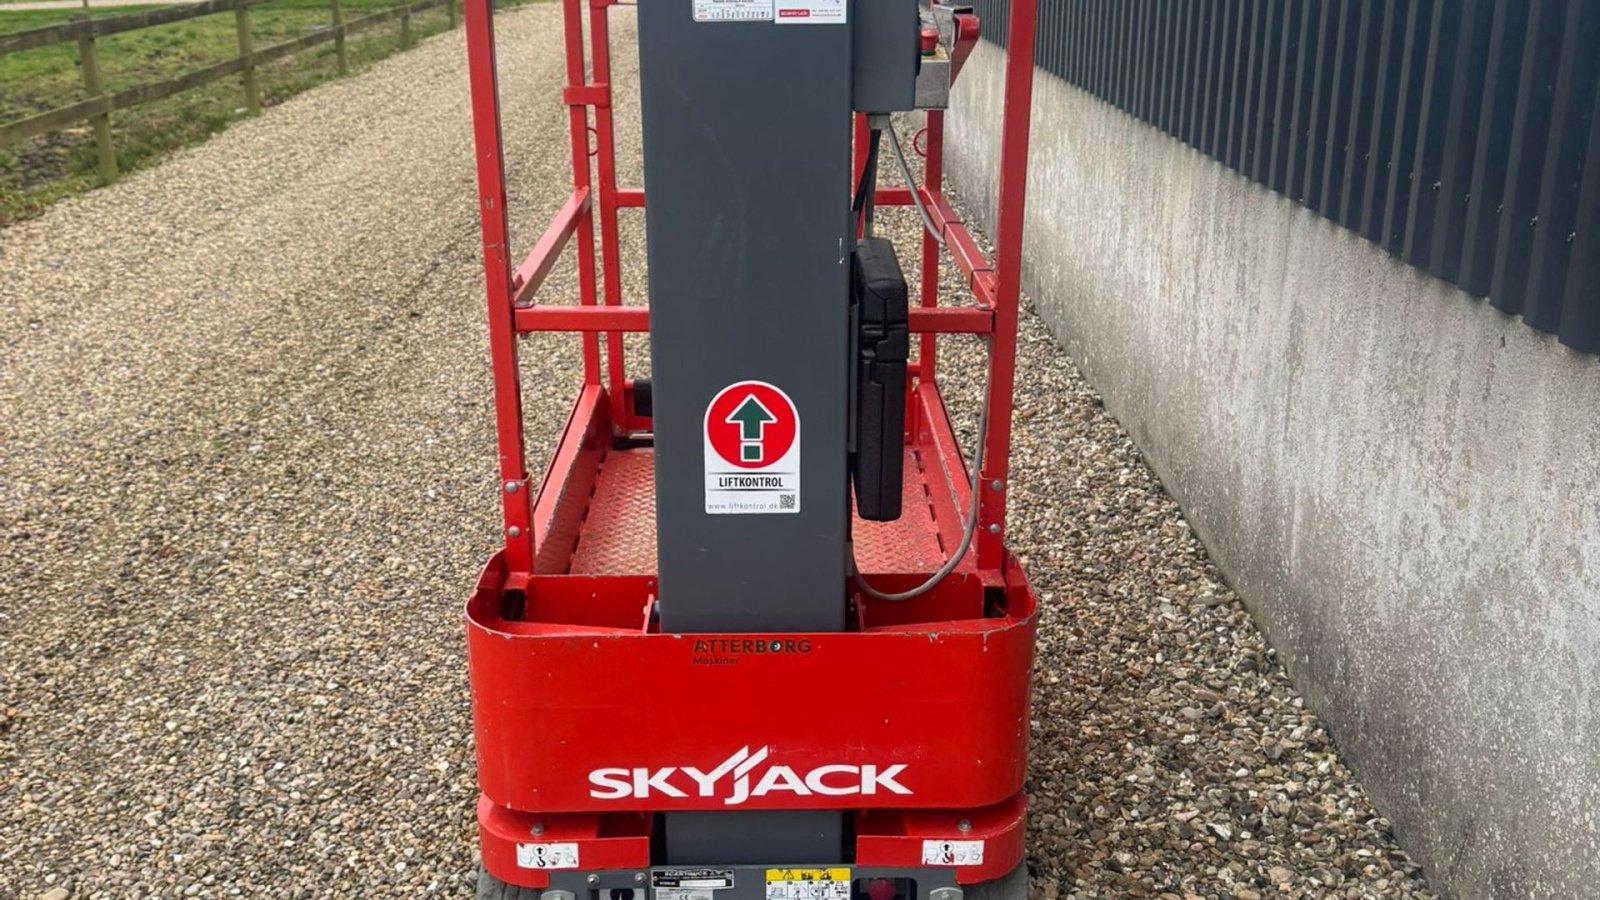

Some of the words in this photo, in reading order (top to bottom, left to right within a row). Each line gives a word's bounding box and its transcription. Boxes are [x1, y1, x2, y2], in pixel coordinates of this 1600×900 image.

[719, 477, 784, 487] LIFTKONTROL
[708, 502, 777, 510] www.liftkontrol.dk
[694, 640, 811, 653] ATTERBORG
[693, 657, 739, 665] Maskiner
[588, 745, 914, 804] SKYJACK
